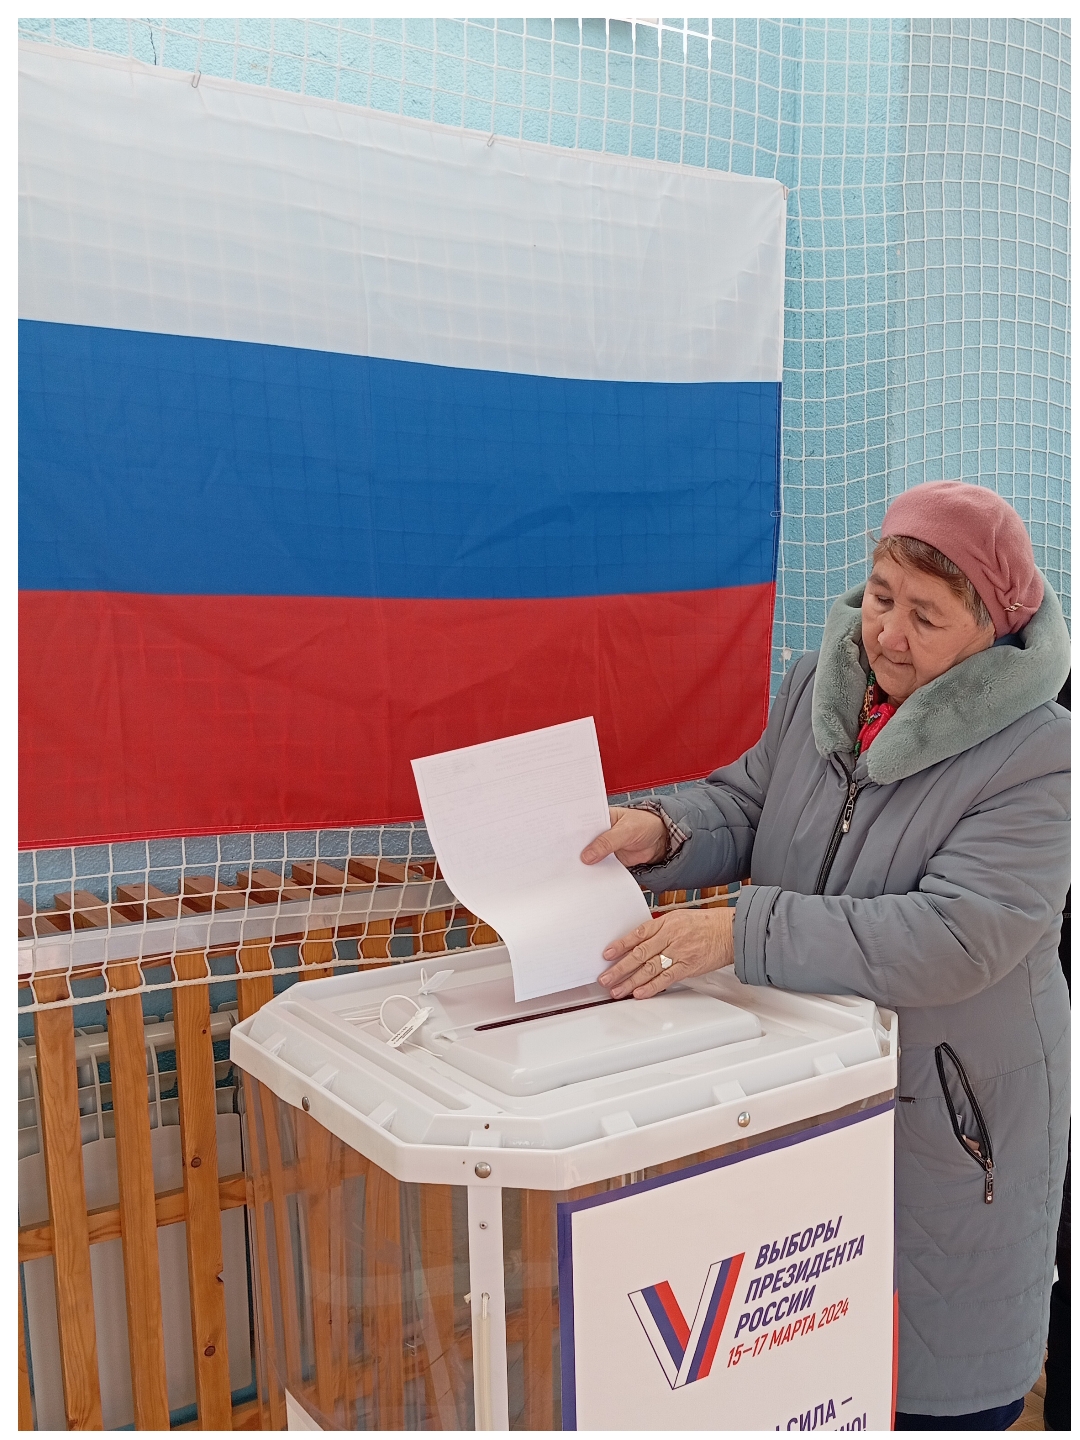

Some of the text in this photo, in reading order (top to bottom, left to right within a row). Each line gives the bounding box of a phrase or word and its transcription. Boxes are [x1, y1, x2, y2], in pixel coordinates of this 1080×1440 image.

[744, 1234, 865, 1304] ПРЕЗИДЕНТА
[754, 1215, 843, 1270] ВЫБОРЫ
[734, 1284, 817, 1339] РОССИИ
[768, 1313, 816, 1350] МАРТА
[818, 1297, 849, 1329] 2024
